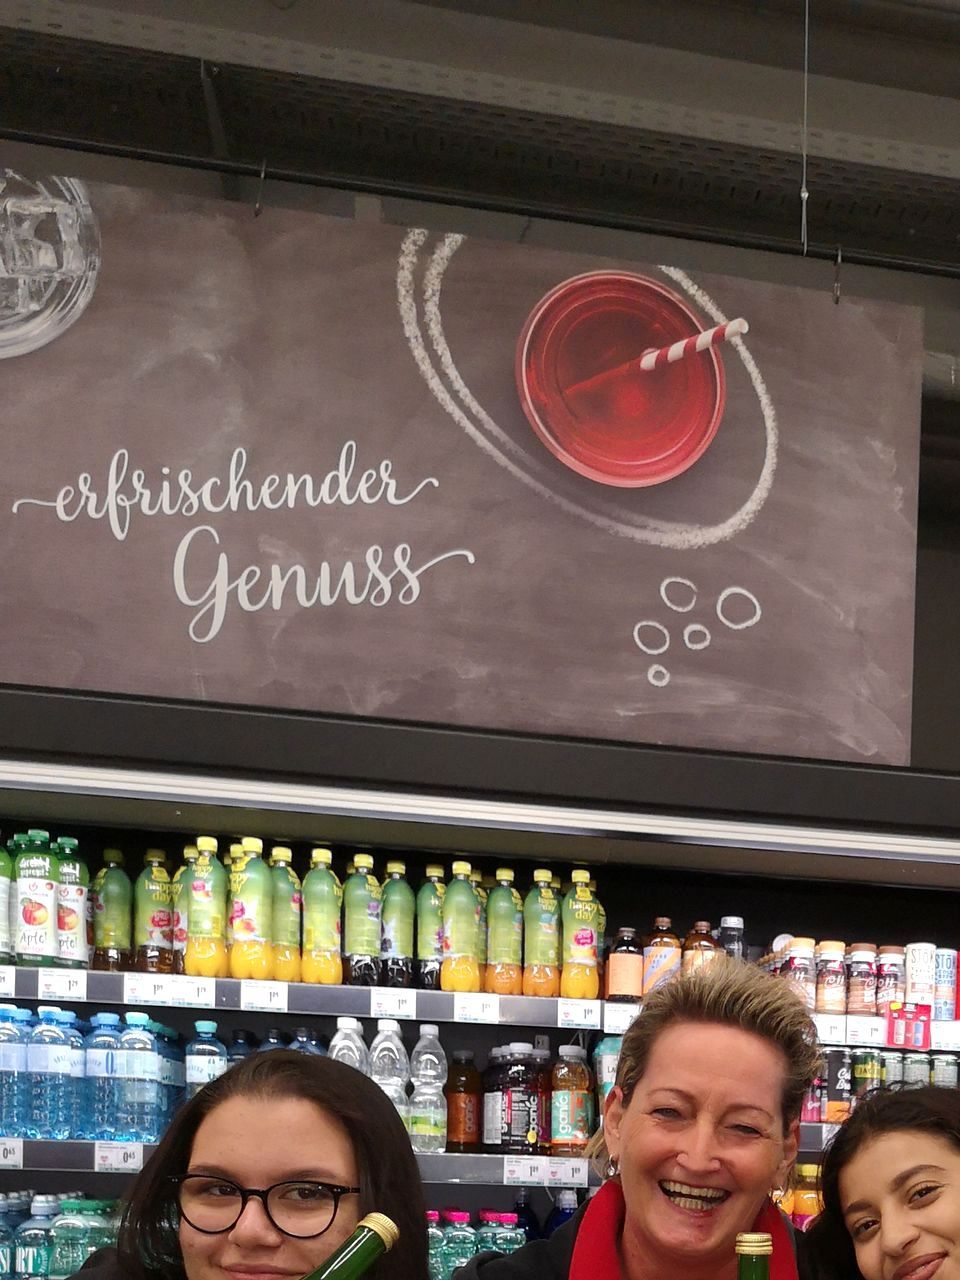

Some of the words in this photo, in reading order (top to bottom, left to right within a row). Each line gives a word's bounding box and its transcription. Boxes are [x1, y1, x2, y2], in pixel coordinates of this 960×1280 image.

[12, 440, 440, 540] erfrischender
[173, 525, 475, 643] Genuss
[569, 899, 598, 914] happy
[575, 909, 594, 922] day
